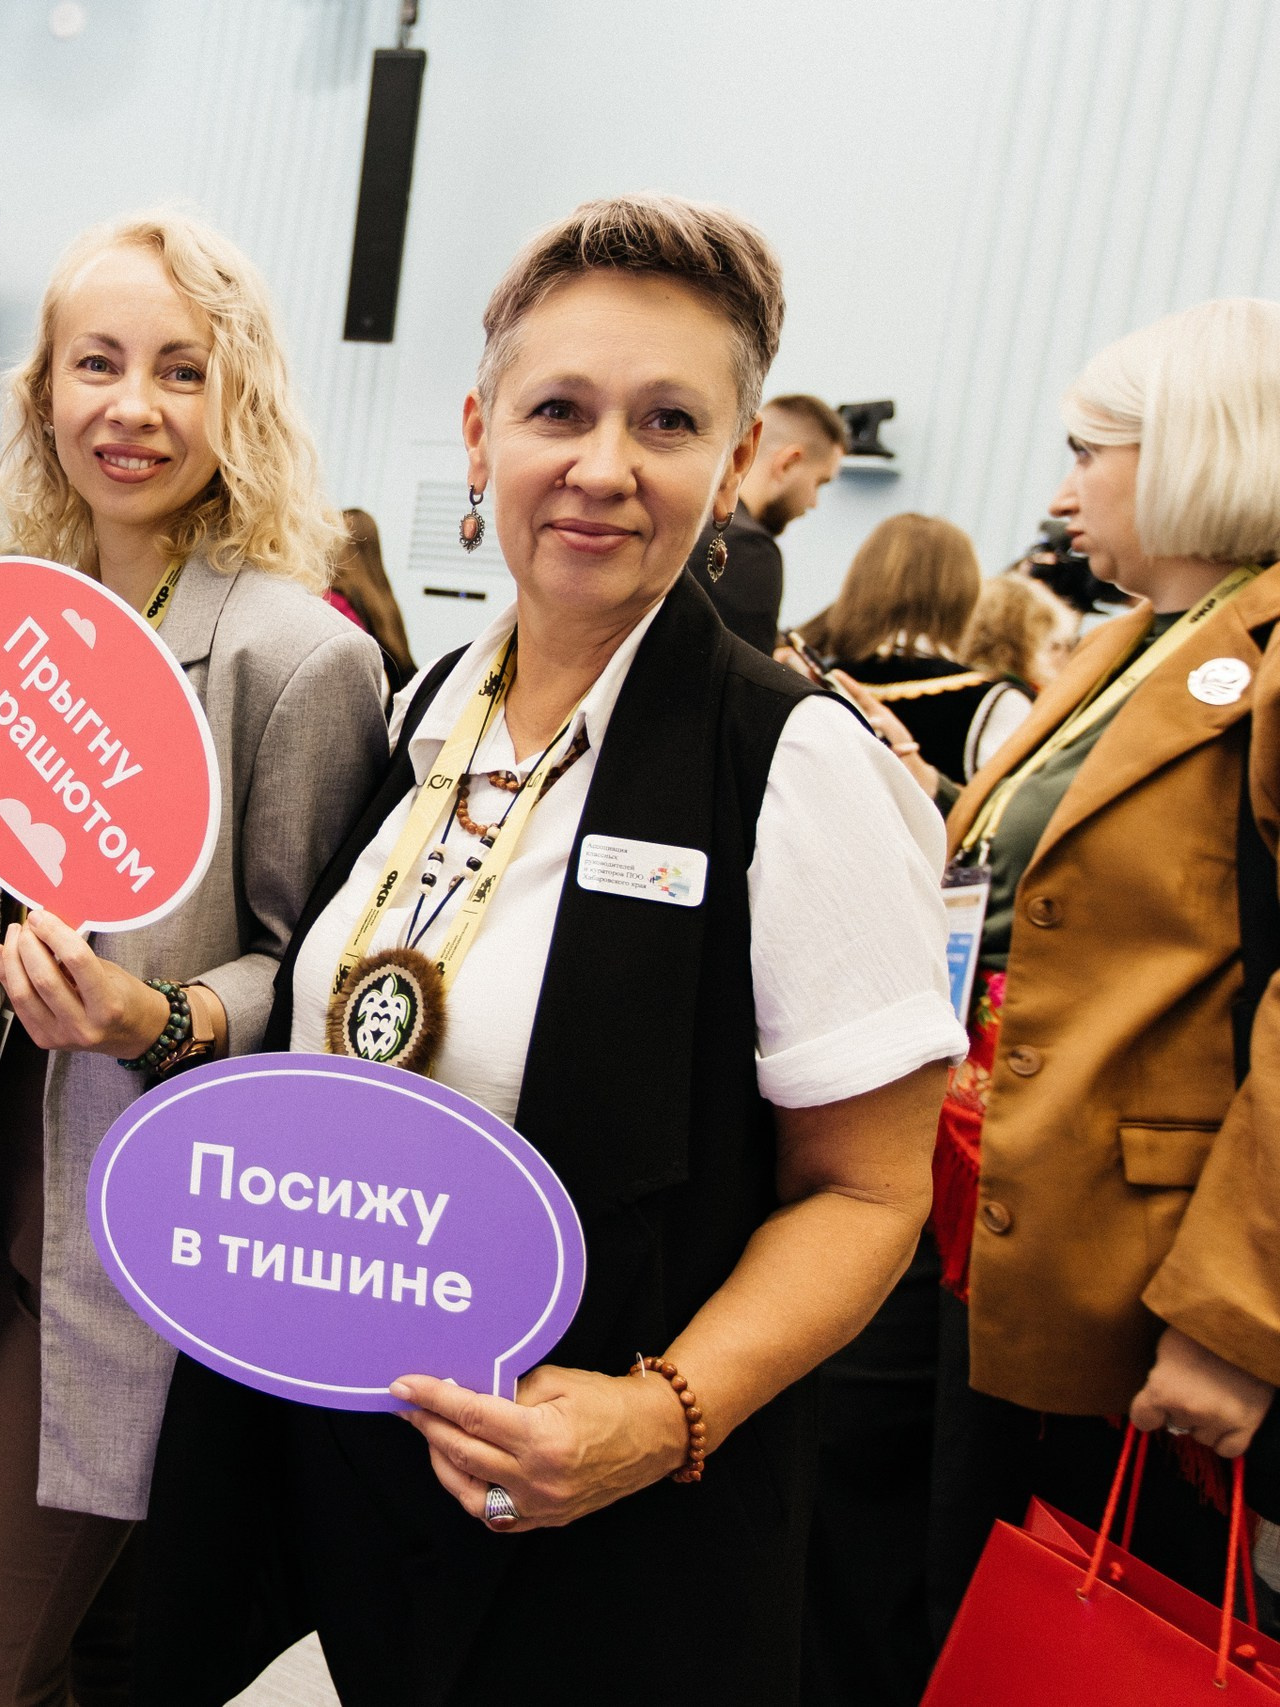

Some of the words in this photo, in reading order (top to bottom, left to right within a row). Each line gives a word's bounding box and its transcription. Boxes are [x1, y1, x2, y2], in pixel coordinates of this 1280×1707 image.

[147, 586, 169, 618] ФКР
[3, 616, 143, 789] Прыгну
[376, 870, 398, 908] ФКР
[189, 1141, 450, 1246] Посижу
[171, 1227, 202, 1267] в
[218, 1234, 473, 1313] тишине
